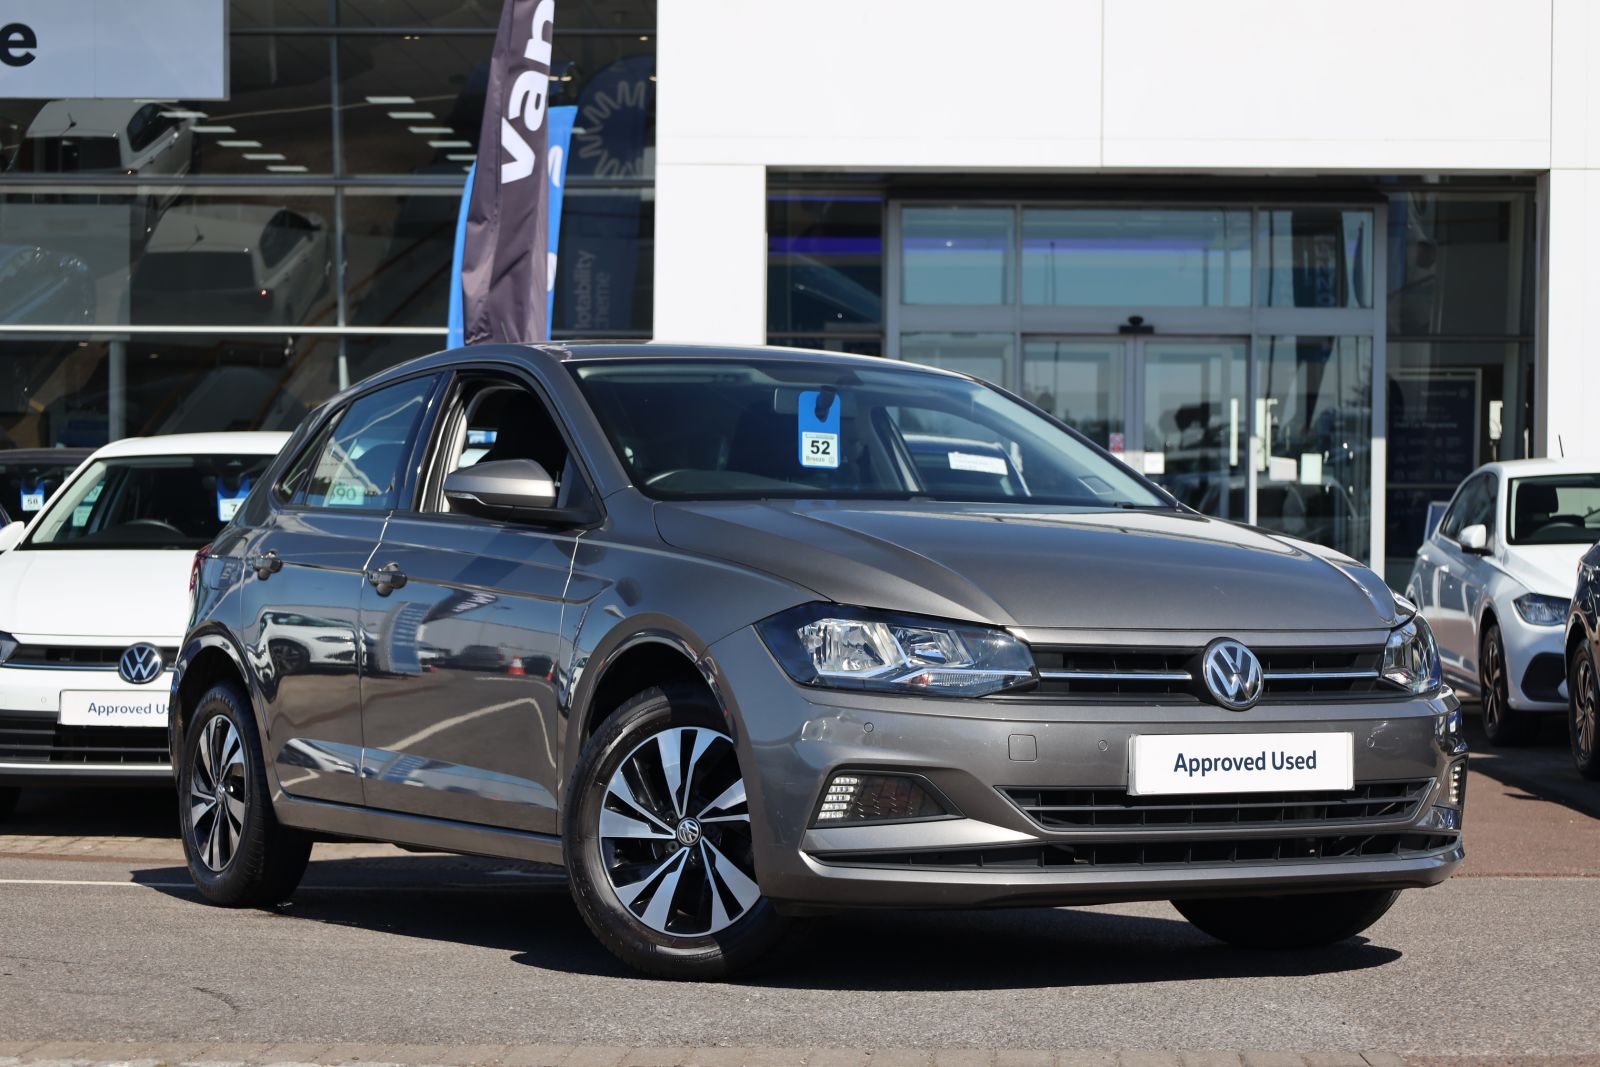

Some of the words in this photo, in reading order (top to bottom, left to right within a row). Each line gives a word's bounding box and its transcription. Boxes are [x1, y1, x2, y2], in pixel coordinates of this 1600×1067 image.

[0, 23, 37, 67] e
[810, 440, 831, 455] 52
[87, 702, 152, 716] Approved
[1173, 750, 1267, 777] Approved
[1271, 749, 1317, 771] Used
